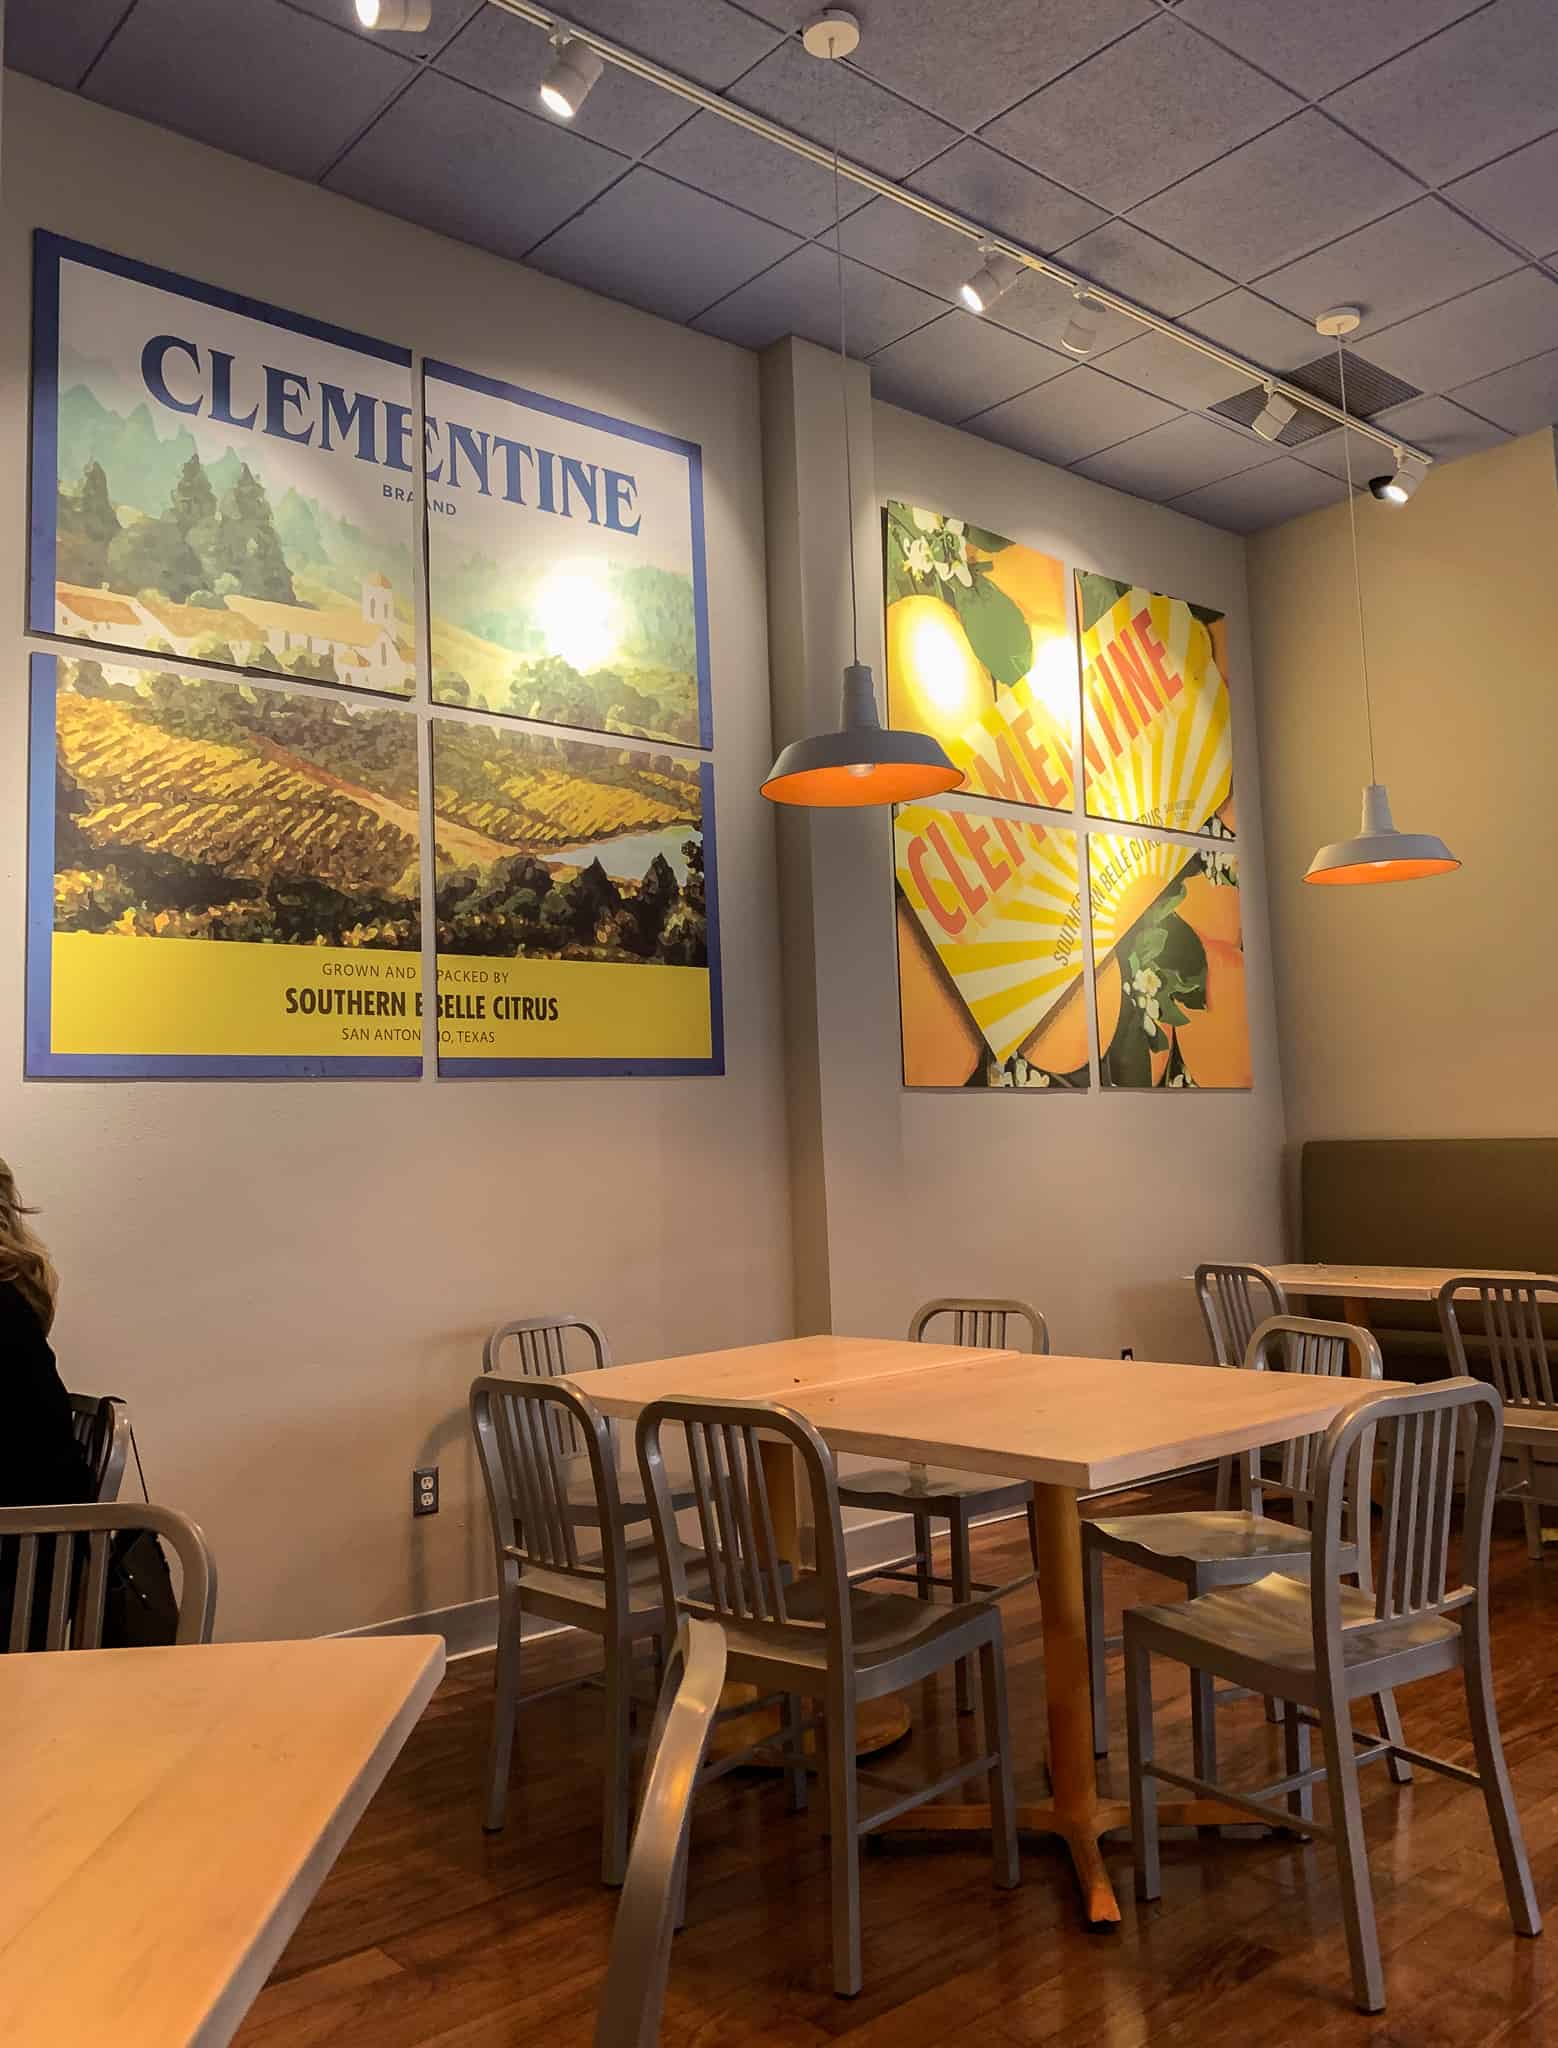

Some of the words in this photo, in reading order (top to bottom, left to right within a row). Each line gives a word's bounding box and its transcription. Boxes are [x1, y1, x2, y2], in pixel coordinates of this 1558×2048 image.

[141, 335, 642, 536] CLEMENTINE
[383, 484, 457, 516] BRAND
[1099, 847, 1131, 892] BELLE
[321, 963, 380, 978] GROWN
[385, 965, 417, 979] AND
[436, 969, 489, 983] PACKED
[494, 972, 509, 983] BY
[285, 987, 406, 1017] SOUTHERN
[415, 992, 486, 1019] BELLE
[493, 996, 559, 1021] CITRUS
[342, 1027, 370, 1041] SAN
[459, 1030, 495, 1043] TEXAS
